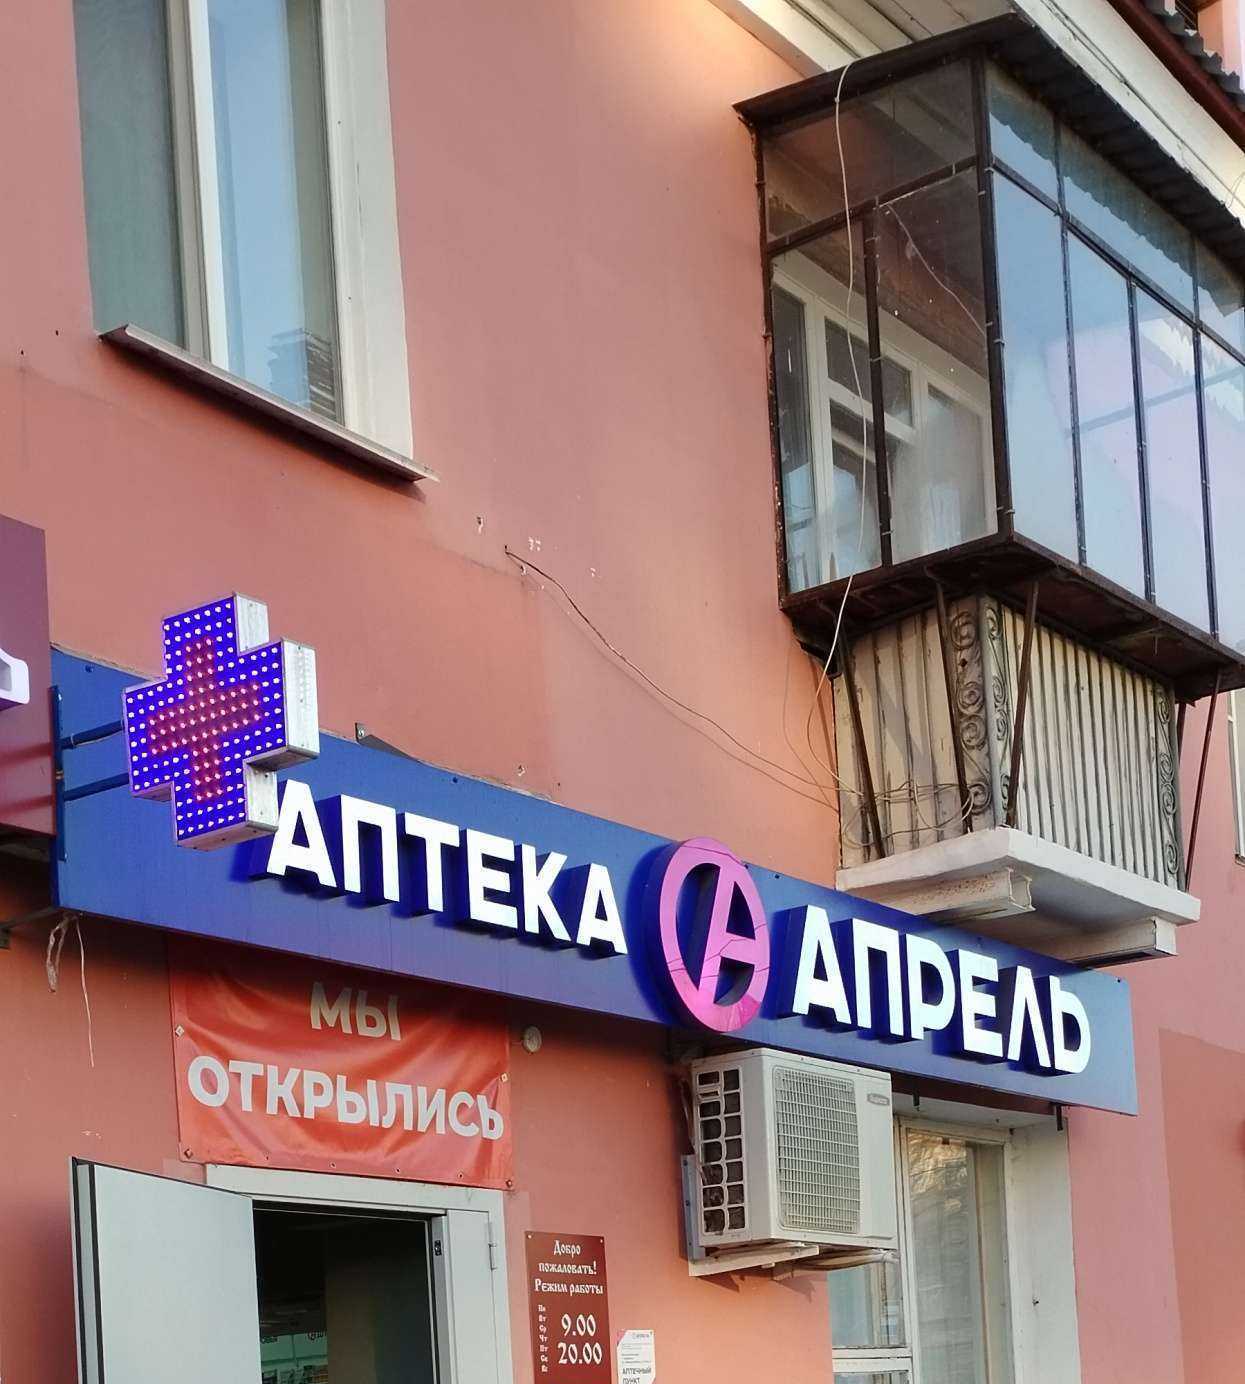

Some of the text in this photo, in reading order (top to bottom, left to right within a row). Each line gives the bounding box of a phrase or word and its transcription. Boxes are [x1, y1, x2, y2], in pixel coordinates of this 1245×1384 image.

[266, 778, 628, 955] АПТЕКА
[792, 904, 1092, 1074] АПРЕЛЬ
[309, 981, 402, 1041] МЫ
[187, 1055, 504, 1141] ОТКРЫЛИСЬ
[553, 1239, 581, 1258] Добро
[538, 1260, 597, 1275] пожаловать!
[534, 1278, 603, 1297] Режим работы
[561, 1313, 596, 1337] 9.00
[557, 1342, 602, 1365] 20.00
